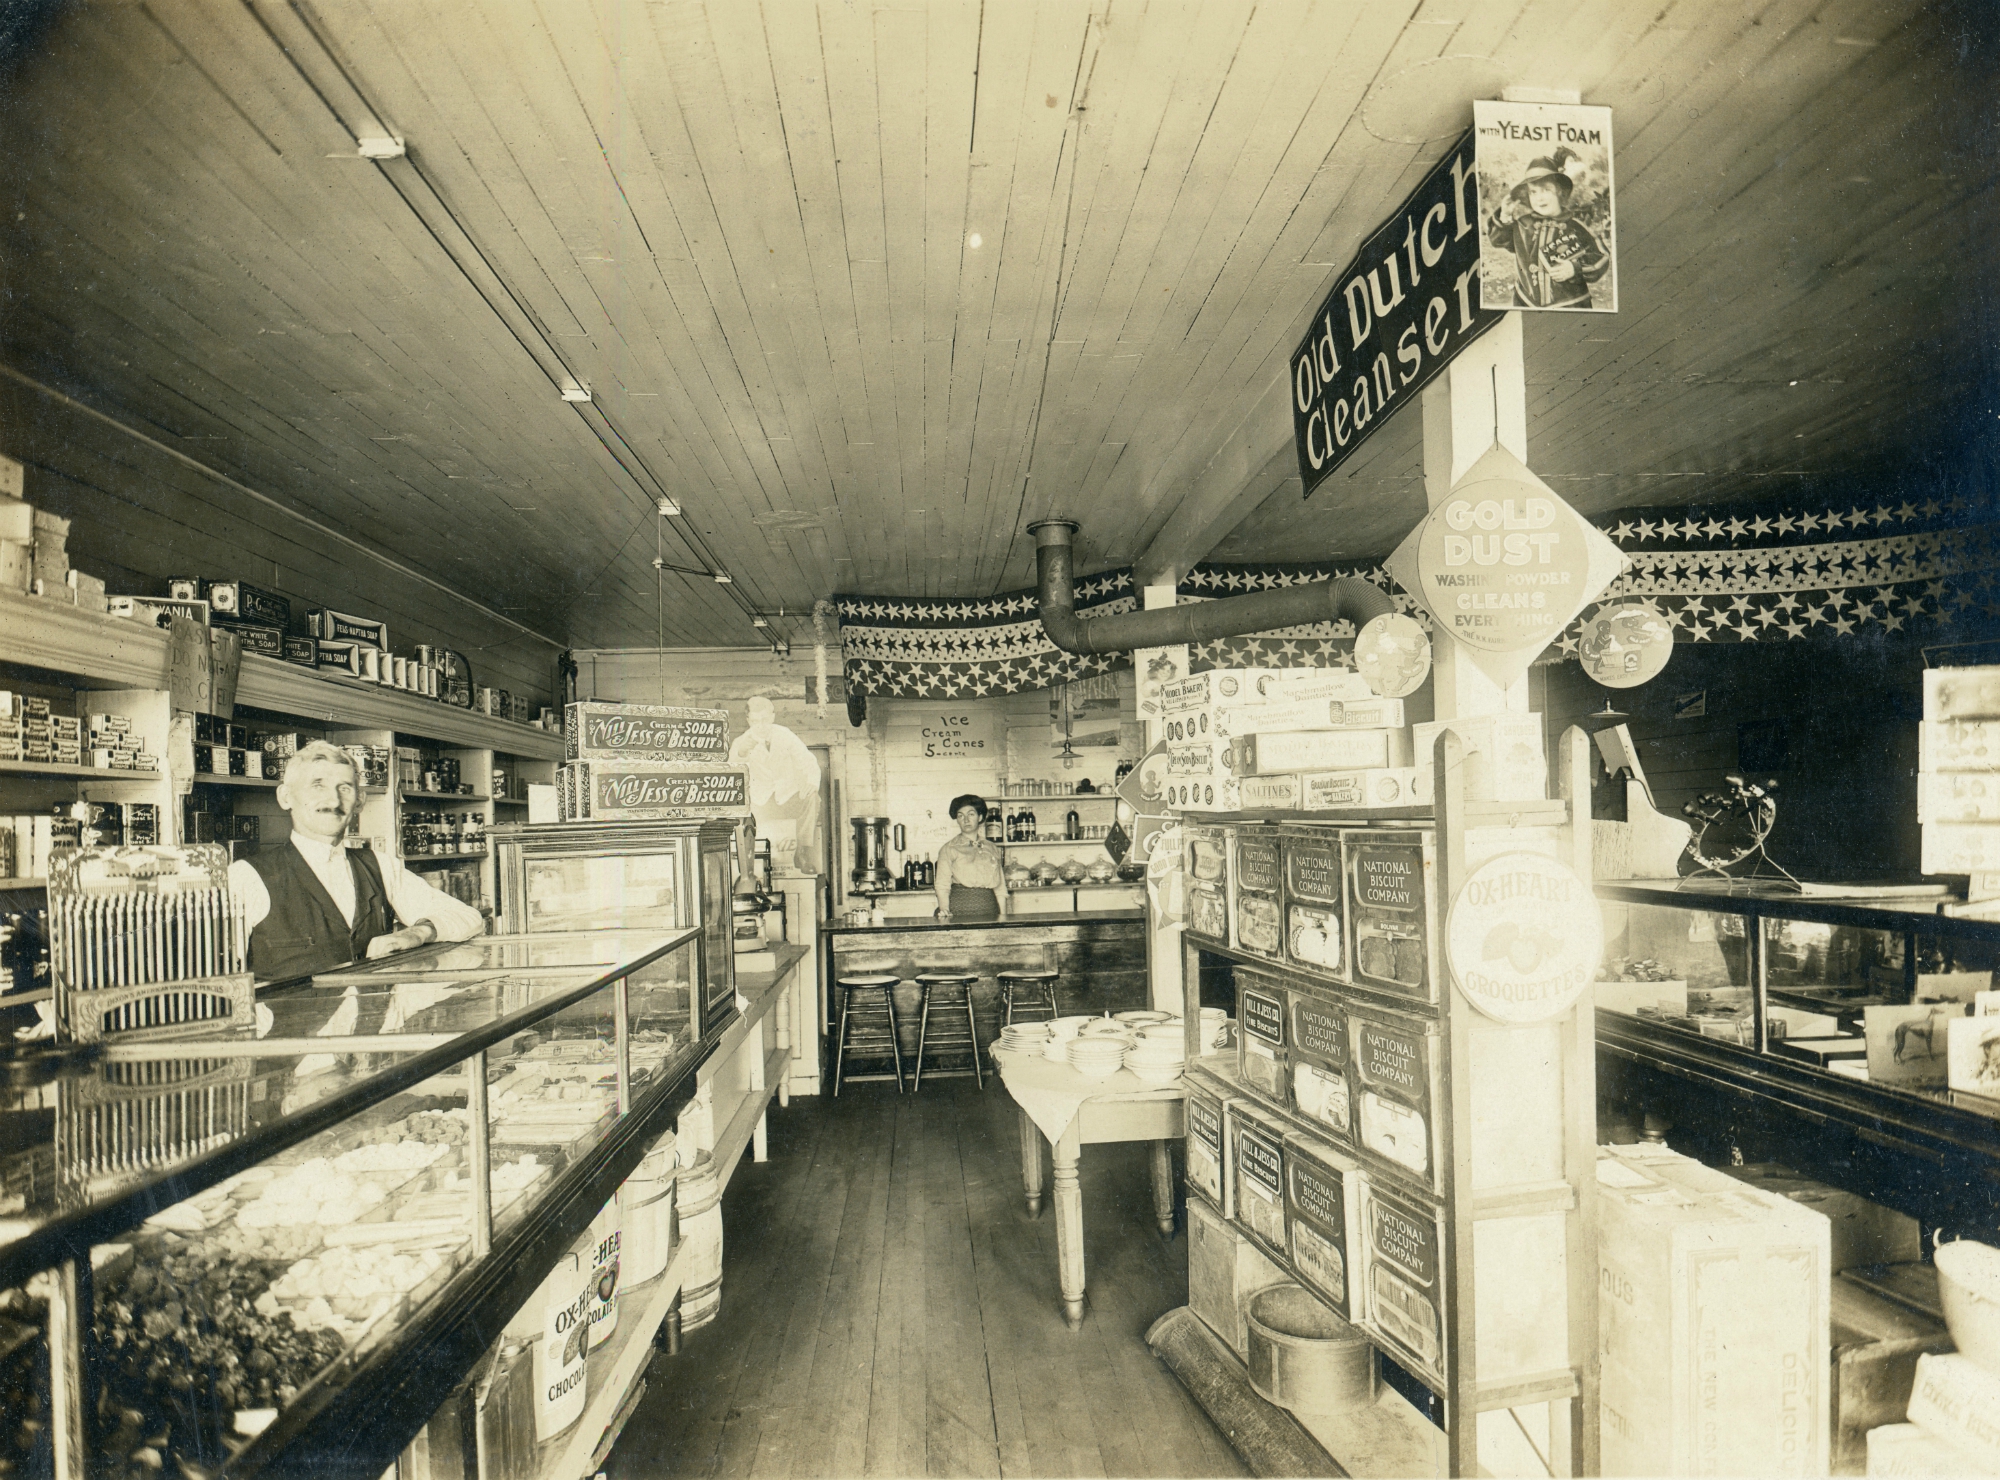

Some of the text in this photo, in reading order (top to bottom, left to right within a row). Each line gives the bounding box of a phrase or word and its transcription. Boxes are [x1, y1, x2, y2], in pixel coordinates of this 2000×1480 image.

[1479, 121, 1601, 145] WITH YEAST FOAM
[1296, 152, 1476, 413] Old Dutch
[1307, 257, 1481, 470] Cleanser
[1446, 498, 1556, 531] GOLD
[1444, 533, 1560, 566] DUST
[1435, 571, 1571, 587] WASHIN POWDER
[1457, 591, 1546, 609] CLEANS
[249, 631, 268, 640] WHITE
[258, 640, 277, 649] SOAP
[173, 648, 191, 667] DO
[333, 653, 347, 663] SOAP
[1282, 683, 1346, 698] Marshmallow
[1294, 693, 1334, 702] Dainties
[940, 716, 969, 726] Ice
[1247, 709, 1305, 720] Marshmallow
[1346, 712, 1381, 726] Biscuit
[1257, 716, 1294, 726] Dainties
[650, 721, 714, 735] CREAM SODA
[922, 728, 961, 737] Cream
[668, 729, 717, 749] BISCUIT
[943, 738, 984, 748] Cones
[666, 776, 735, 788] CREAM SODA
[1246, 782, 1292, 799] SALTINES
[685, 784, 738, 804] BISCUIT
[1245, 851, 1275, 863] NATIONAL
[1296, 857, 1334, 870] NATIONAL
[1249, 862, 1271, 874] BISCUIT
[1301, 869, 1327, 882] BISCUIT
[1363, 861, 1411, 874] NATIONAL
[1246, 873, 1274, 885] COMPANY
[1298, 881, 1332, 895] COMPANY
[1370, 875, 1405, 888] BISCUIT
[1367, 889, 1410, 903] COMPANY
[1467, 871, 1573, 906] OX-HEART
[1465, 963, 1587, 1003] CROQUETTES
[1260, 1004, 1272, 1020] JESS
[1302, 1010, 1342, 1032] NATIONAL
[1256, 1018, 1279, 1037] BISCUITS
[1307, 1024, 1337, 1042] BISCUIT
[1305, 1036, 1341, 1057] COMPANY
[1367, 1033, 1416, 1059] NATIONAL
[1373, 1049, 1408, 1069] BISCUIT
[1370, 1061, 1414, 1087] COMPANY
[1258, 1149, 1270, 1167] JESS
[1253, 1162, 1277, 1186] BISCUITS
[1297, 1169, 1335, 1203] NATIONAL
[1303, 1185, 1331, 1211] BISCUIT
[1300, 1196, 1335, 1226] COMPANY
[1377, 1208, 1425, 1245] NATIONAL
[1384, 1226, 1419, 1255] BISCUIT
[1381, 1237, 1424, 1273] COMPANY
[548, 1360, 588, 1402] CHOCOLA
